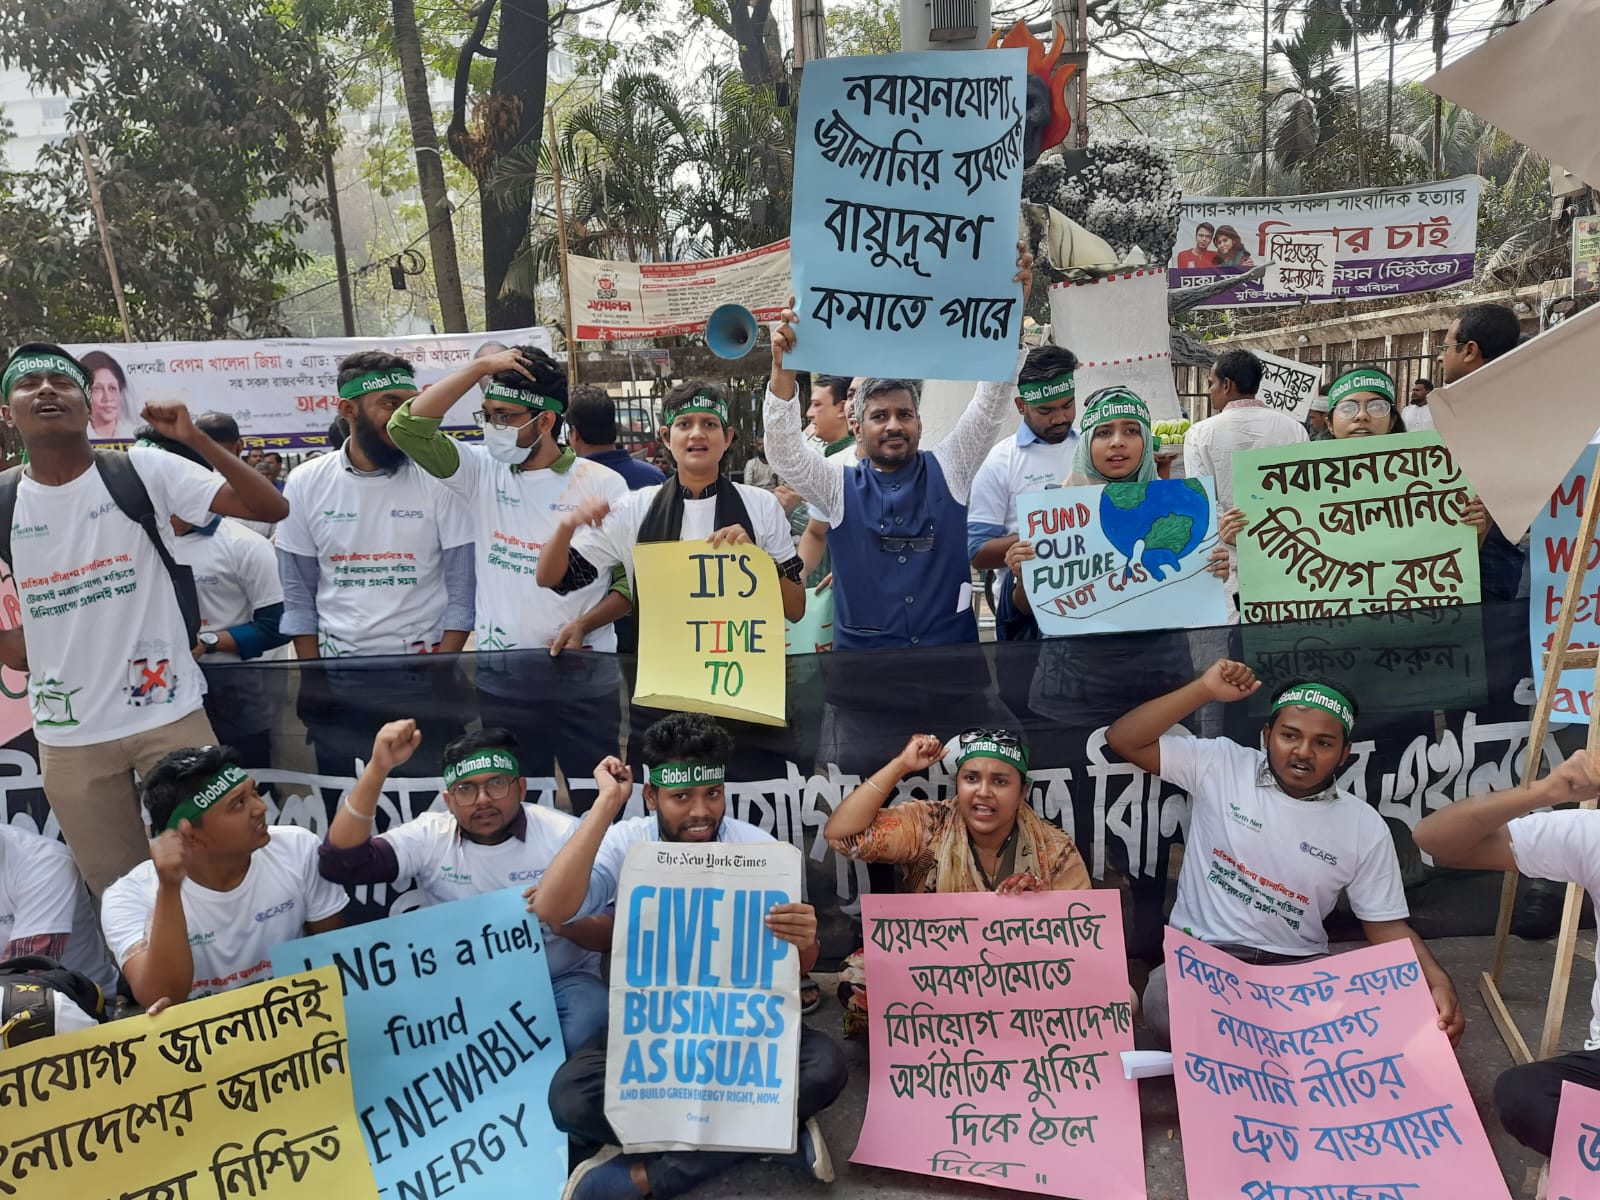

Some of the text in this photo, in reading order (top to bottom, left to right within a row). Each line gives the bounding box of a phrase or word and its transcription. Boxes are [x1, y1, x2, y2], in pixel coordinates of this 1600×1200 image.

[815, 109, 944, 190] জ্বালানির
[1338, 191, 1410, 209] সাংবাদিক
[1417, 188, 1466, 206] হত্যার
[824, 198, 994, 277] বায়ুদূষণ
[1385, 216, 1451, 250] চাই
[810, 287, 933, 331] কমাতে
[940, 298, 1016, 340] পারে
[17, 358, 54, 372] Global
[170, 358, 204, 373] বেগম
[209, 356, 249, 372] খালেদা
[254, 352, 282, 369] জিয়া
[430, 350, 470, 362] আহমেদ
[362, 375, 391, 391] Global
[489, 383, 545, 407] Climate Strike
[1042, 382, 1069, 397] Climate
[1353, 376, 1386, 388] Climate
[1102, 403, 1136, 416] Climate
[1028, 503, 1090, 538] FUND
[1035, 535, 1085, 560] OUR
[688, 554, 758, 598] IT'S
[1033, 552, 1114, 594] FUTURE
[1392, 548, 1463, 593] করে
[1054, 585, 1096, 616] NOT
[686, 620, 767, 653] TIME
[705, 661, 744, 697] TO
[1305, 690, 1341, 714] Climate
[456, 756, 491, 776] Climate
[967, 741, 1021, 761] Climate Strike
[193, 776, 231, 809] Global
[662, 766, 690, 784] Global
[1250, 818, 1263, 829] Net
[657, 851, 767, 868] The New York Times
[1309, 846, 1338, 866] CAPS
[265, 900, 294, 919] CAPS
[982, 902, 1106, 949] এলএনজি
[625, 884, 790, 990] GIVE UP
[304, 919, 541, 996] NG is a fuel,
[1246, 971, 1340, 1012] সংকট
[1344, 961, 1419, 996] এড়াতে
[384, 997, 468, 1055] fund
[623, 990, 785, 1039] BUSINESS
[884, 1002, 1005, 1047] বিনিয়োগ
[1211, 1006, 1381, 1058] নবায়নযোগ্য
[0, 1034, 147, 1108] নযোগ্য
[216, 1031, 347, 1112] জ্বালানি
[620, 1038, 782, 1089] AS USUAL
[889, 1048, 1018, 1099] অর্থনৈতিক
[1184, 1049, 1406, 1107] জ্বালানি নীতির
[360, 1001, 552, 1164] ENEWABLE
[620, 1088, 638, 1100] AND
[640, 1088, 667, 1100] BUILD
[667, 1088, 693, 1100] GREEN
[694, 1089, 726, 1102] ENERGY
[946, 1103, 1098, 1147] দিকে ঠেলে
[1233, 1104, 1464, 1163] দ্রুত বাস্তবায়ন
[377, 1103, 528, 1200] NERGY
